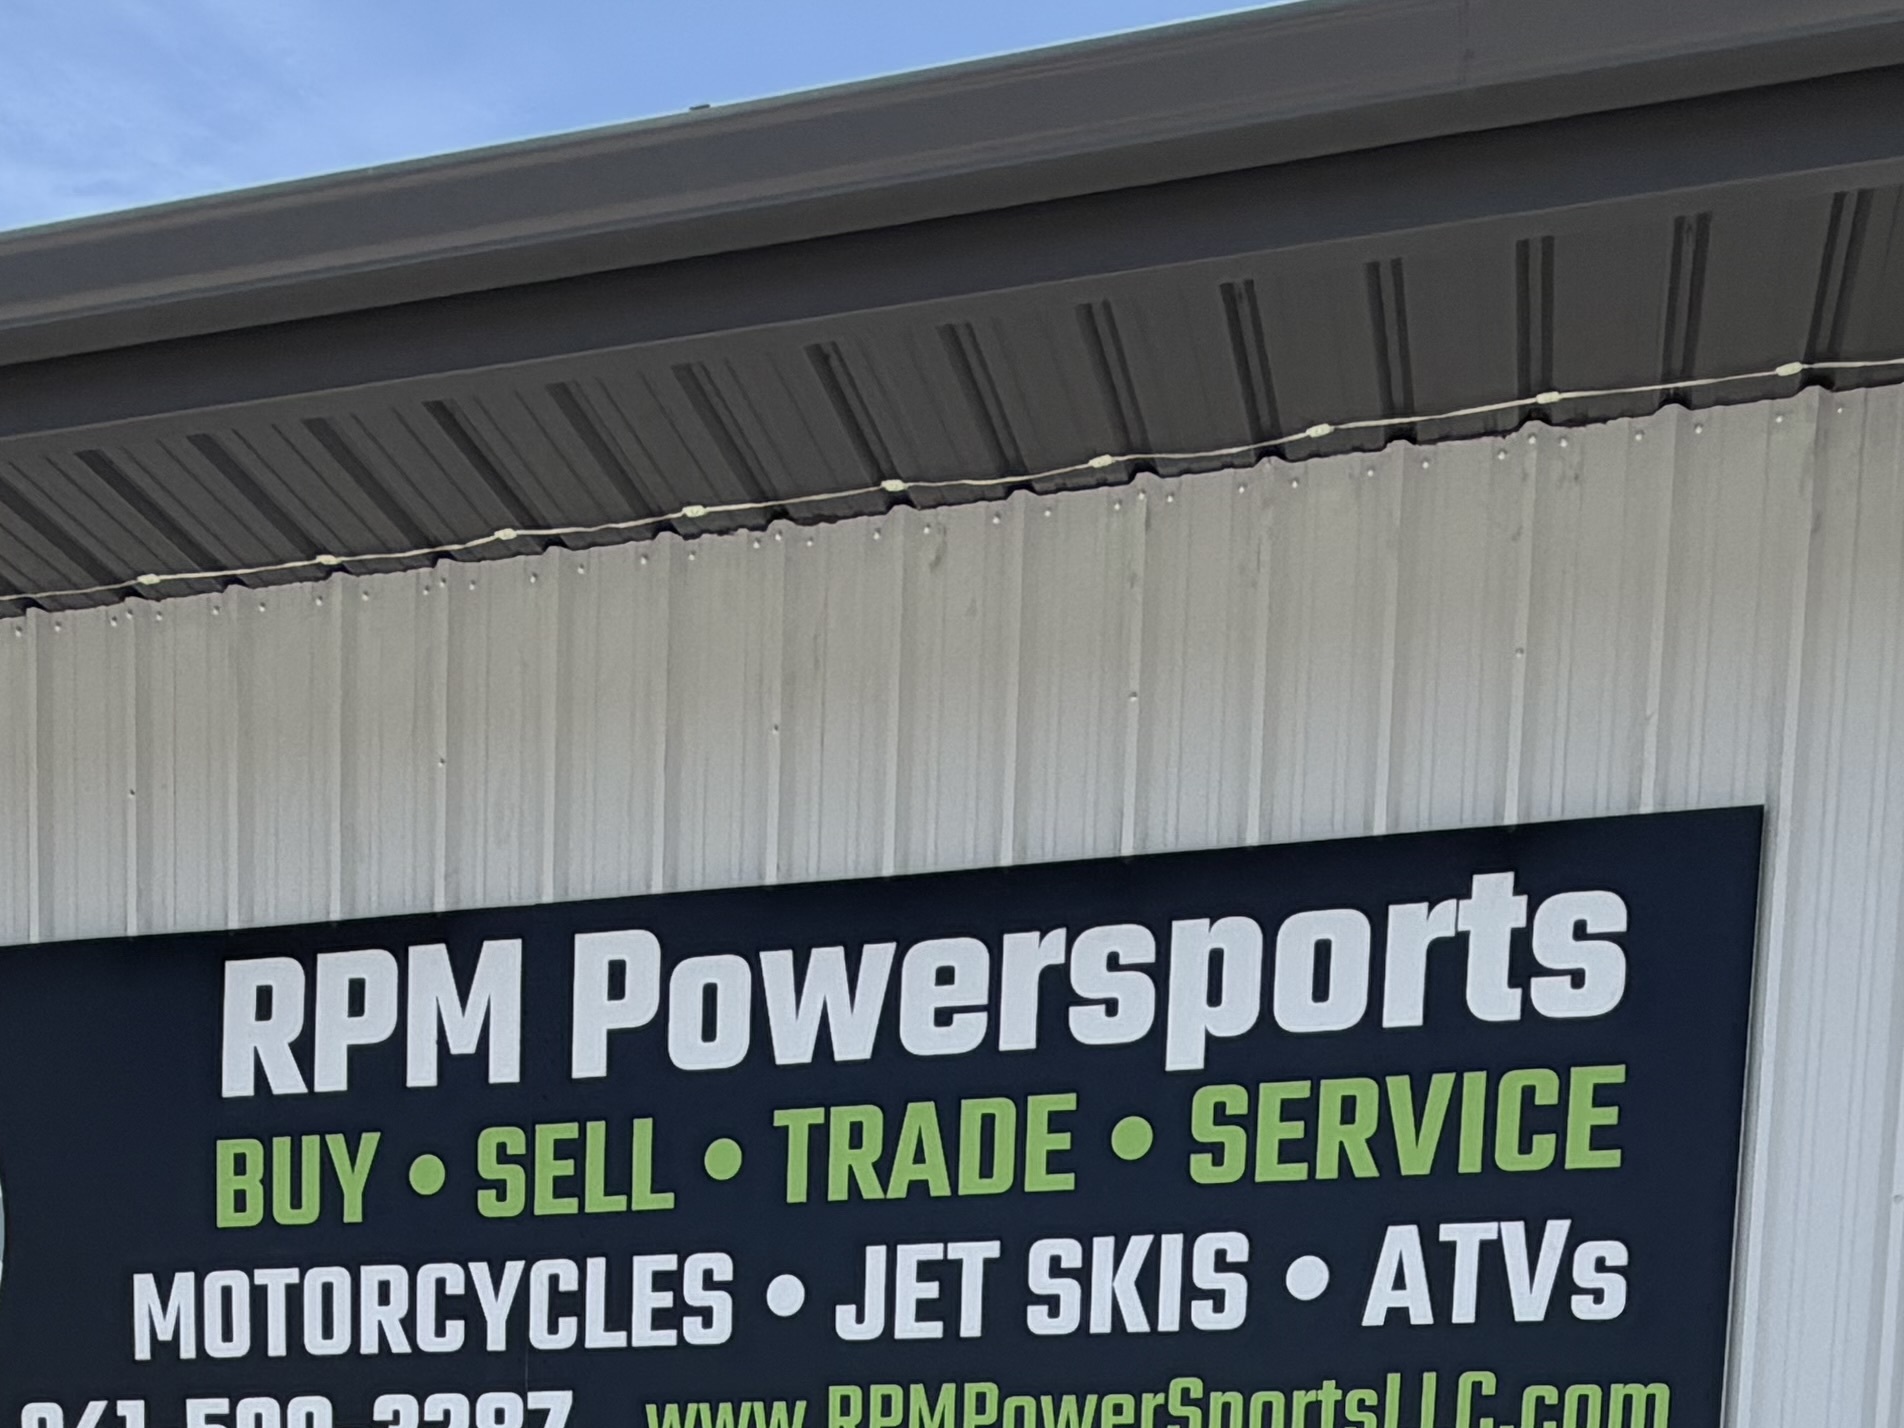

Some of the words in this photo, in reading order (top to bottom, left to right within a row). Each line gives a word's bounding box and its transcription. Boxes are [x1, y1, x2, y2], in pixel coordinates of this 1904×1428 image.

[220, 937, 524, 1099] RPM
[570, 870, 1629, 1080] Powersports
[216, 1131, 381, 1228] BUY
[477, 1117, 675, 1218] SELL
[773, 1092, 1077, 1204] TRADE
[1180, 1049, 1626, 1184] SERVICE
[133, 1252, 734, 1361] MOTORCYCLES
[835, 1240, 1001, 1341] JET
[1026, 1231, 1250, 1335] SKIS
[1361, 1219, 1629, 1327] ATVs
